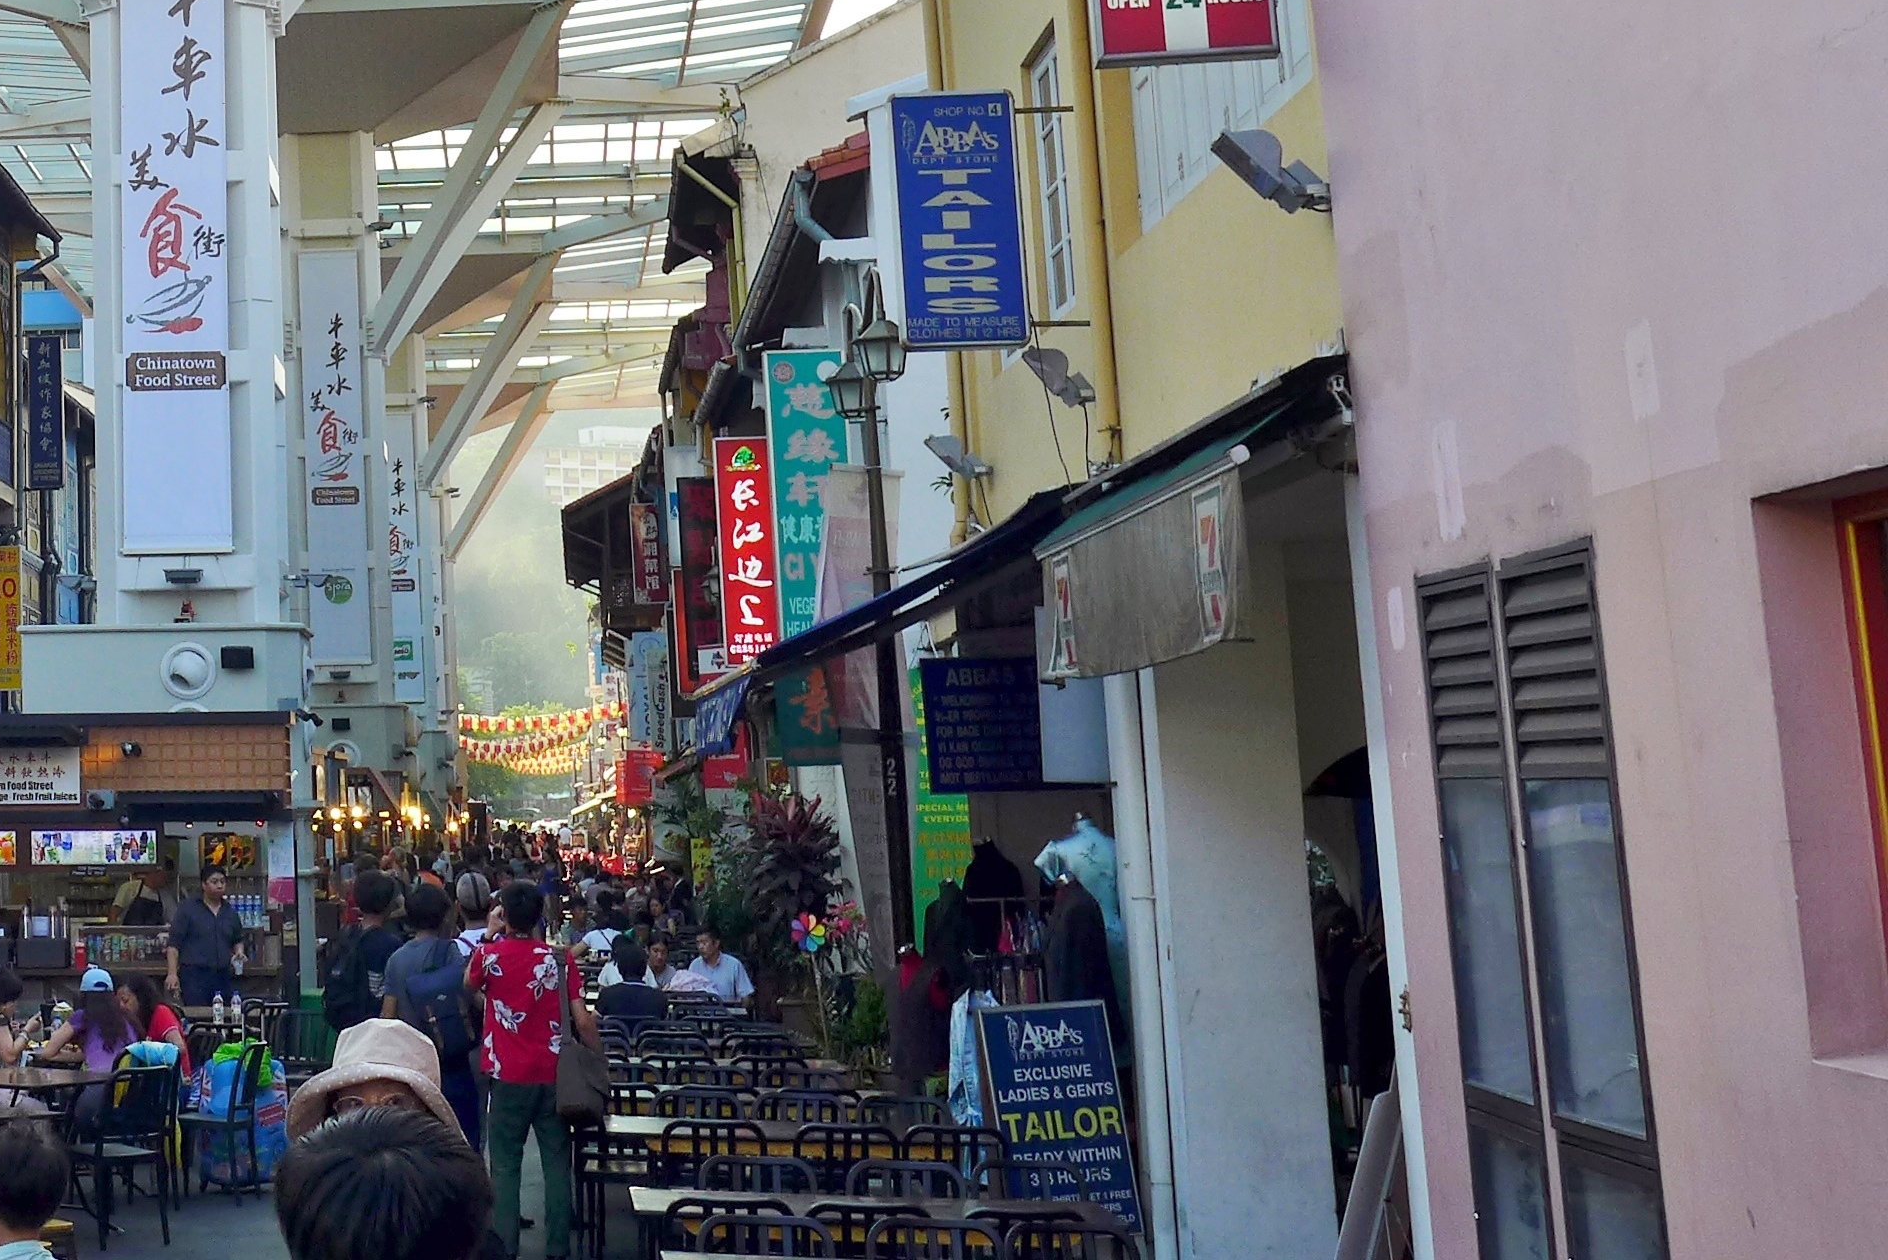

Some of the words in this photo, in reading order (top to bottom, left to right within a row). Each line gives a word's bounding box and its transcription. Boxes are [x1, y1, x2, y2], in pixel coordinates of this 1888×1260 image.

[933, 107, 963, 116] SHOP
[989, 104, 999, 116] 4
[913, 156, 945, 165] DEPT
[956, 154, 999, 164] STORE
[917, 168, 1001, 314] TAILORS
[908, 317, 940, 327] MADE
[944, 317, 961, 327] TO
[964, 316, 1020, 326] MEASURE
[908, 328, 961, 339] CLOTHES
[966, 328, 977, 338] IN
[982, 327, 992, 337] 12
[997, 327, 1021, 337] HRS
[135, 356, 217, 371] Chinatown
[135, 373, 172, 387] Food
[176, 372, 218, 386] Street
[7, 781, 27, 790] Food
[28, 781, 54, 791] Street
[1014, 1063, 1093, 1083] EXCLUSIVE
[998, 1086, 1049, 1104] LADIES
[1053, 1084, 1063, 1100] &
[1066, 1081, 1114, 1097] GENTS
[1001, 1106, 1123, 1144] TAILOR
[1068, 1146, 1122, 1162] WITHIN
[1109, 1190, 1132, 1199] FREE
